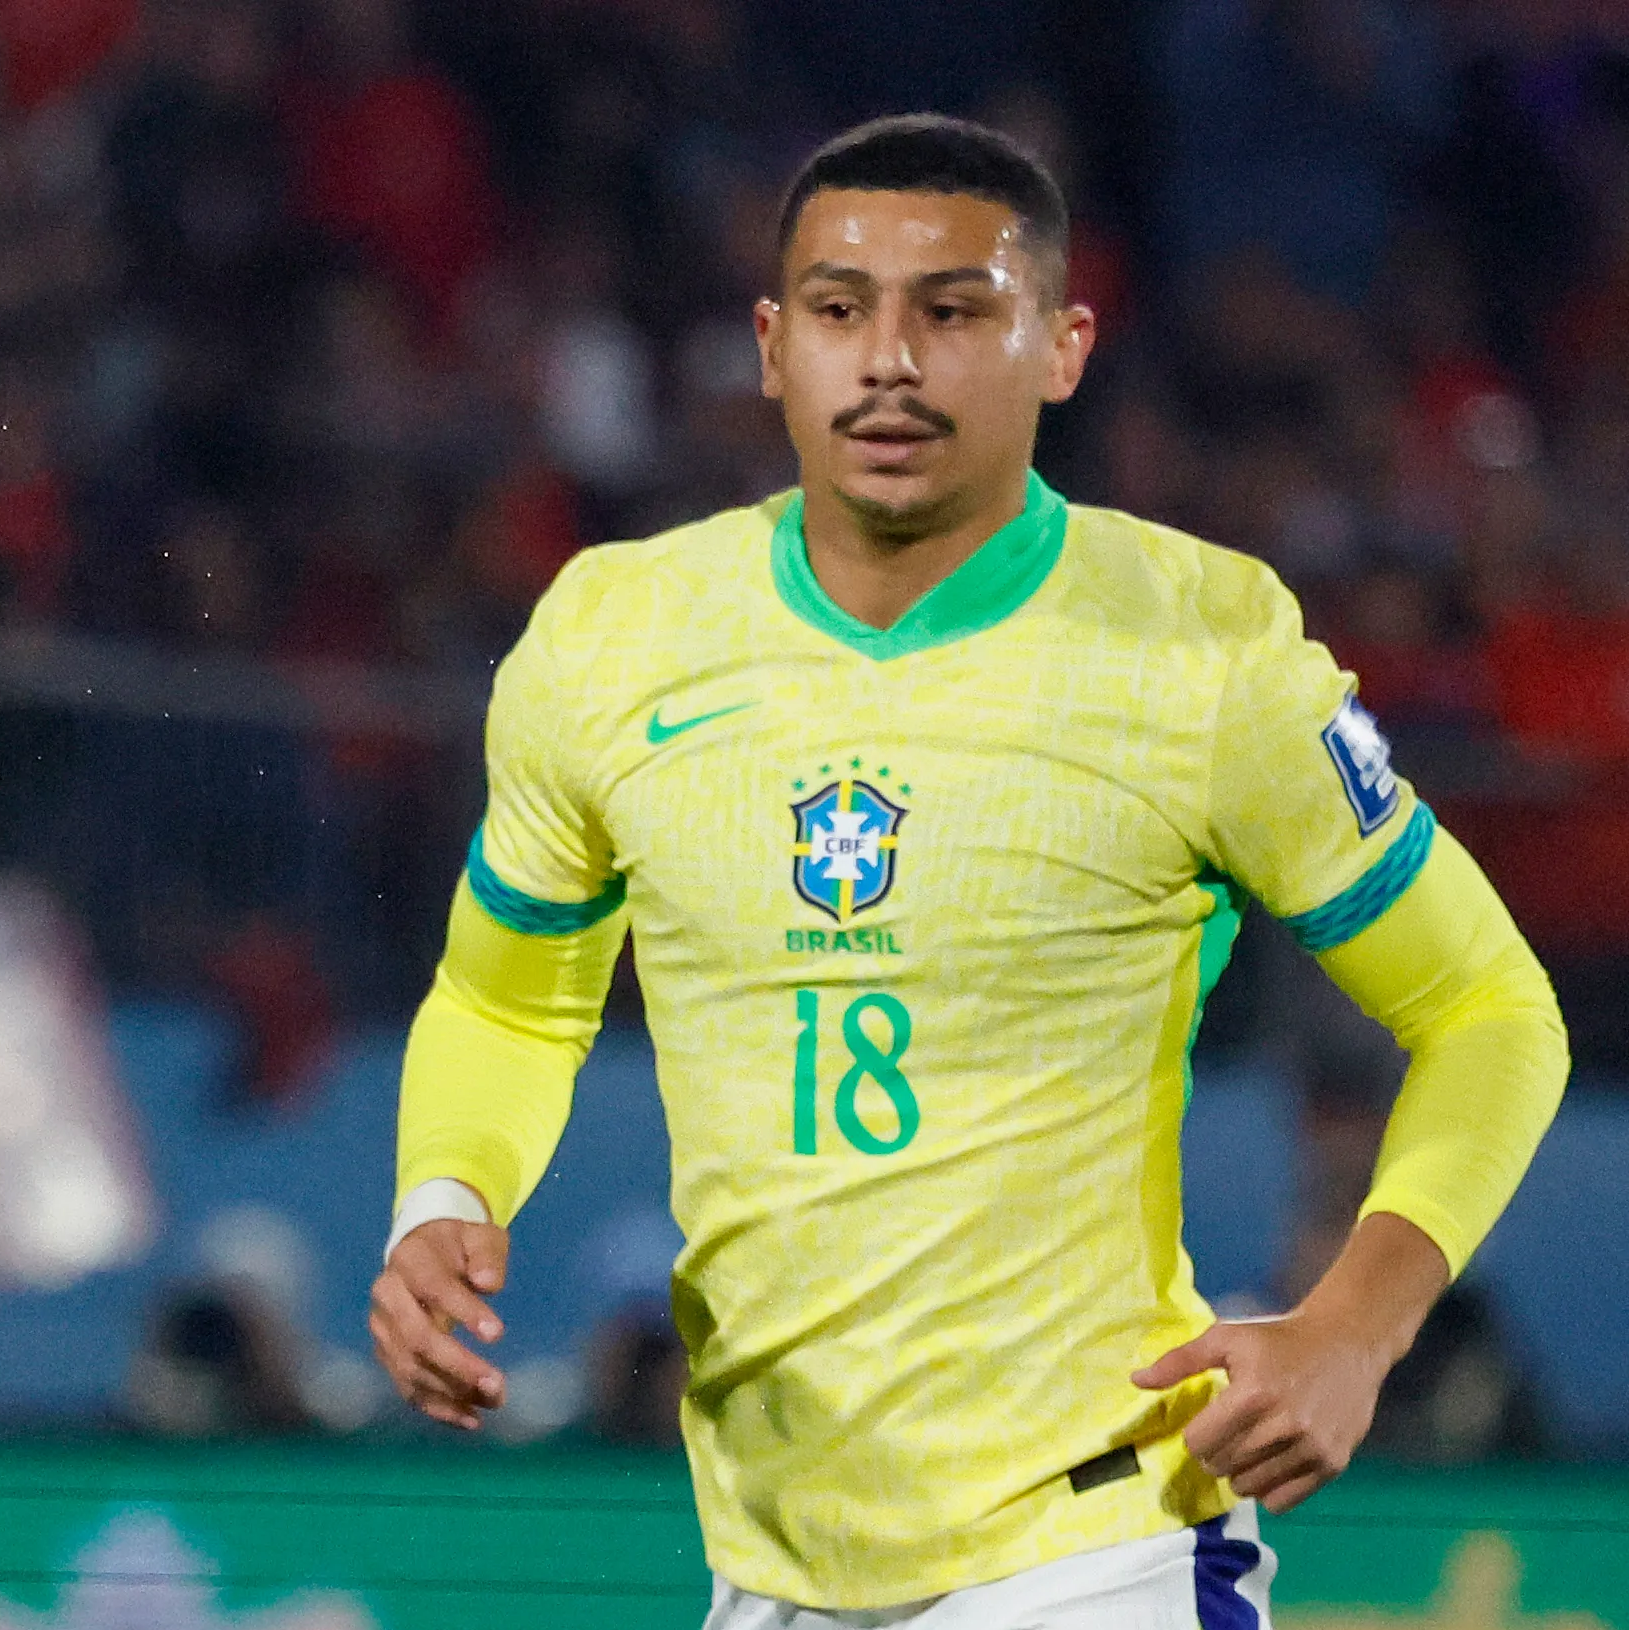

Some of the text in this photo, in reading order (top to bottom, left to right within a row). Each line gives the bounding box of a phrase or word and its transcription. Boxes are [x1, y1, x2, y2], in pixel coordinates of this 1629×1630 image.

[825, 837, 866, 856] CBF
[786, 929, 904, 955] BRASIL
[794, 988, 921, 1157] 18
